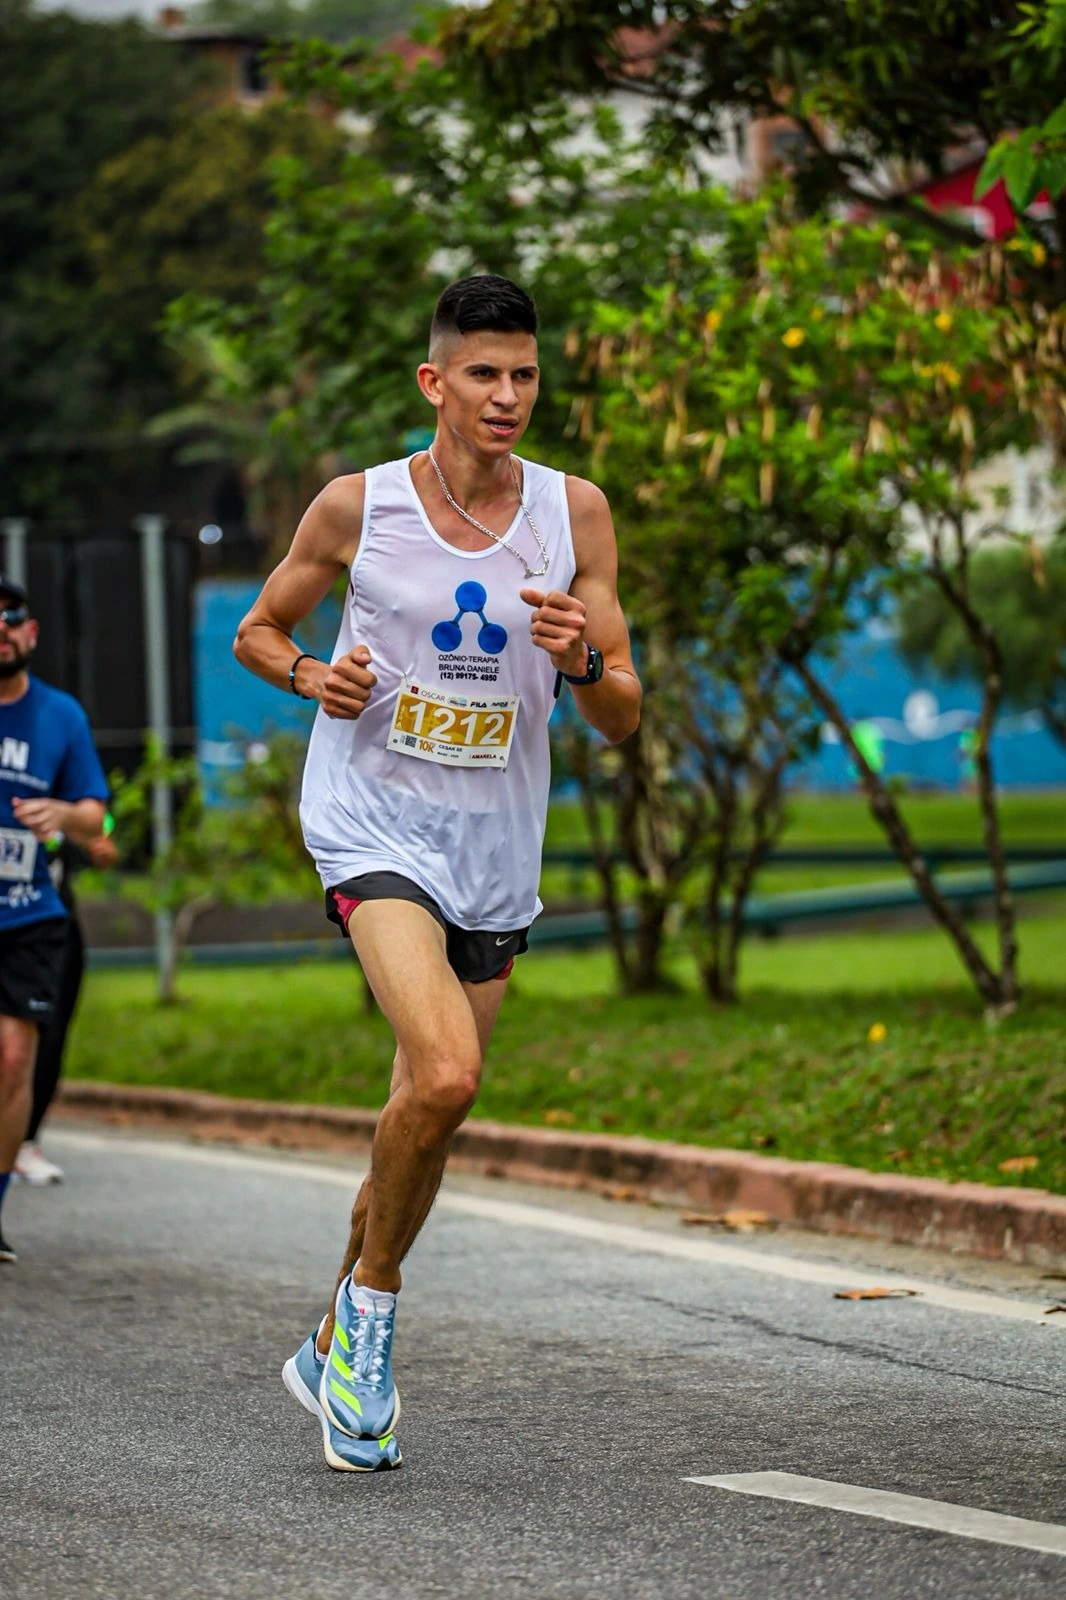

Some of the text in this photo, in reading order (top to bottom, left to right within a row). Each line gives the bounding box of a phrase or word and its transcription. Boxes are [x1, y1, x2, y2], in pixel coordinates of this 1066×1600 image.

[438, 664, 500, 674] BRUNA DANIELE
[440, 672, 498, 682] (12) 99175- 4950
[421, 689, 446, 702] OSCAR
[409, 701, 505, 745] 1212
